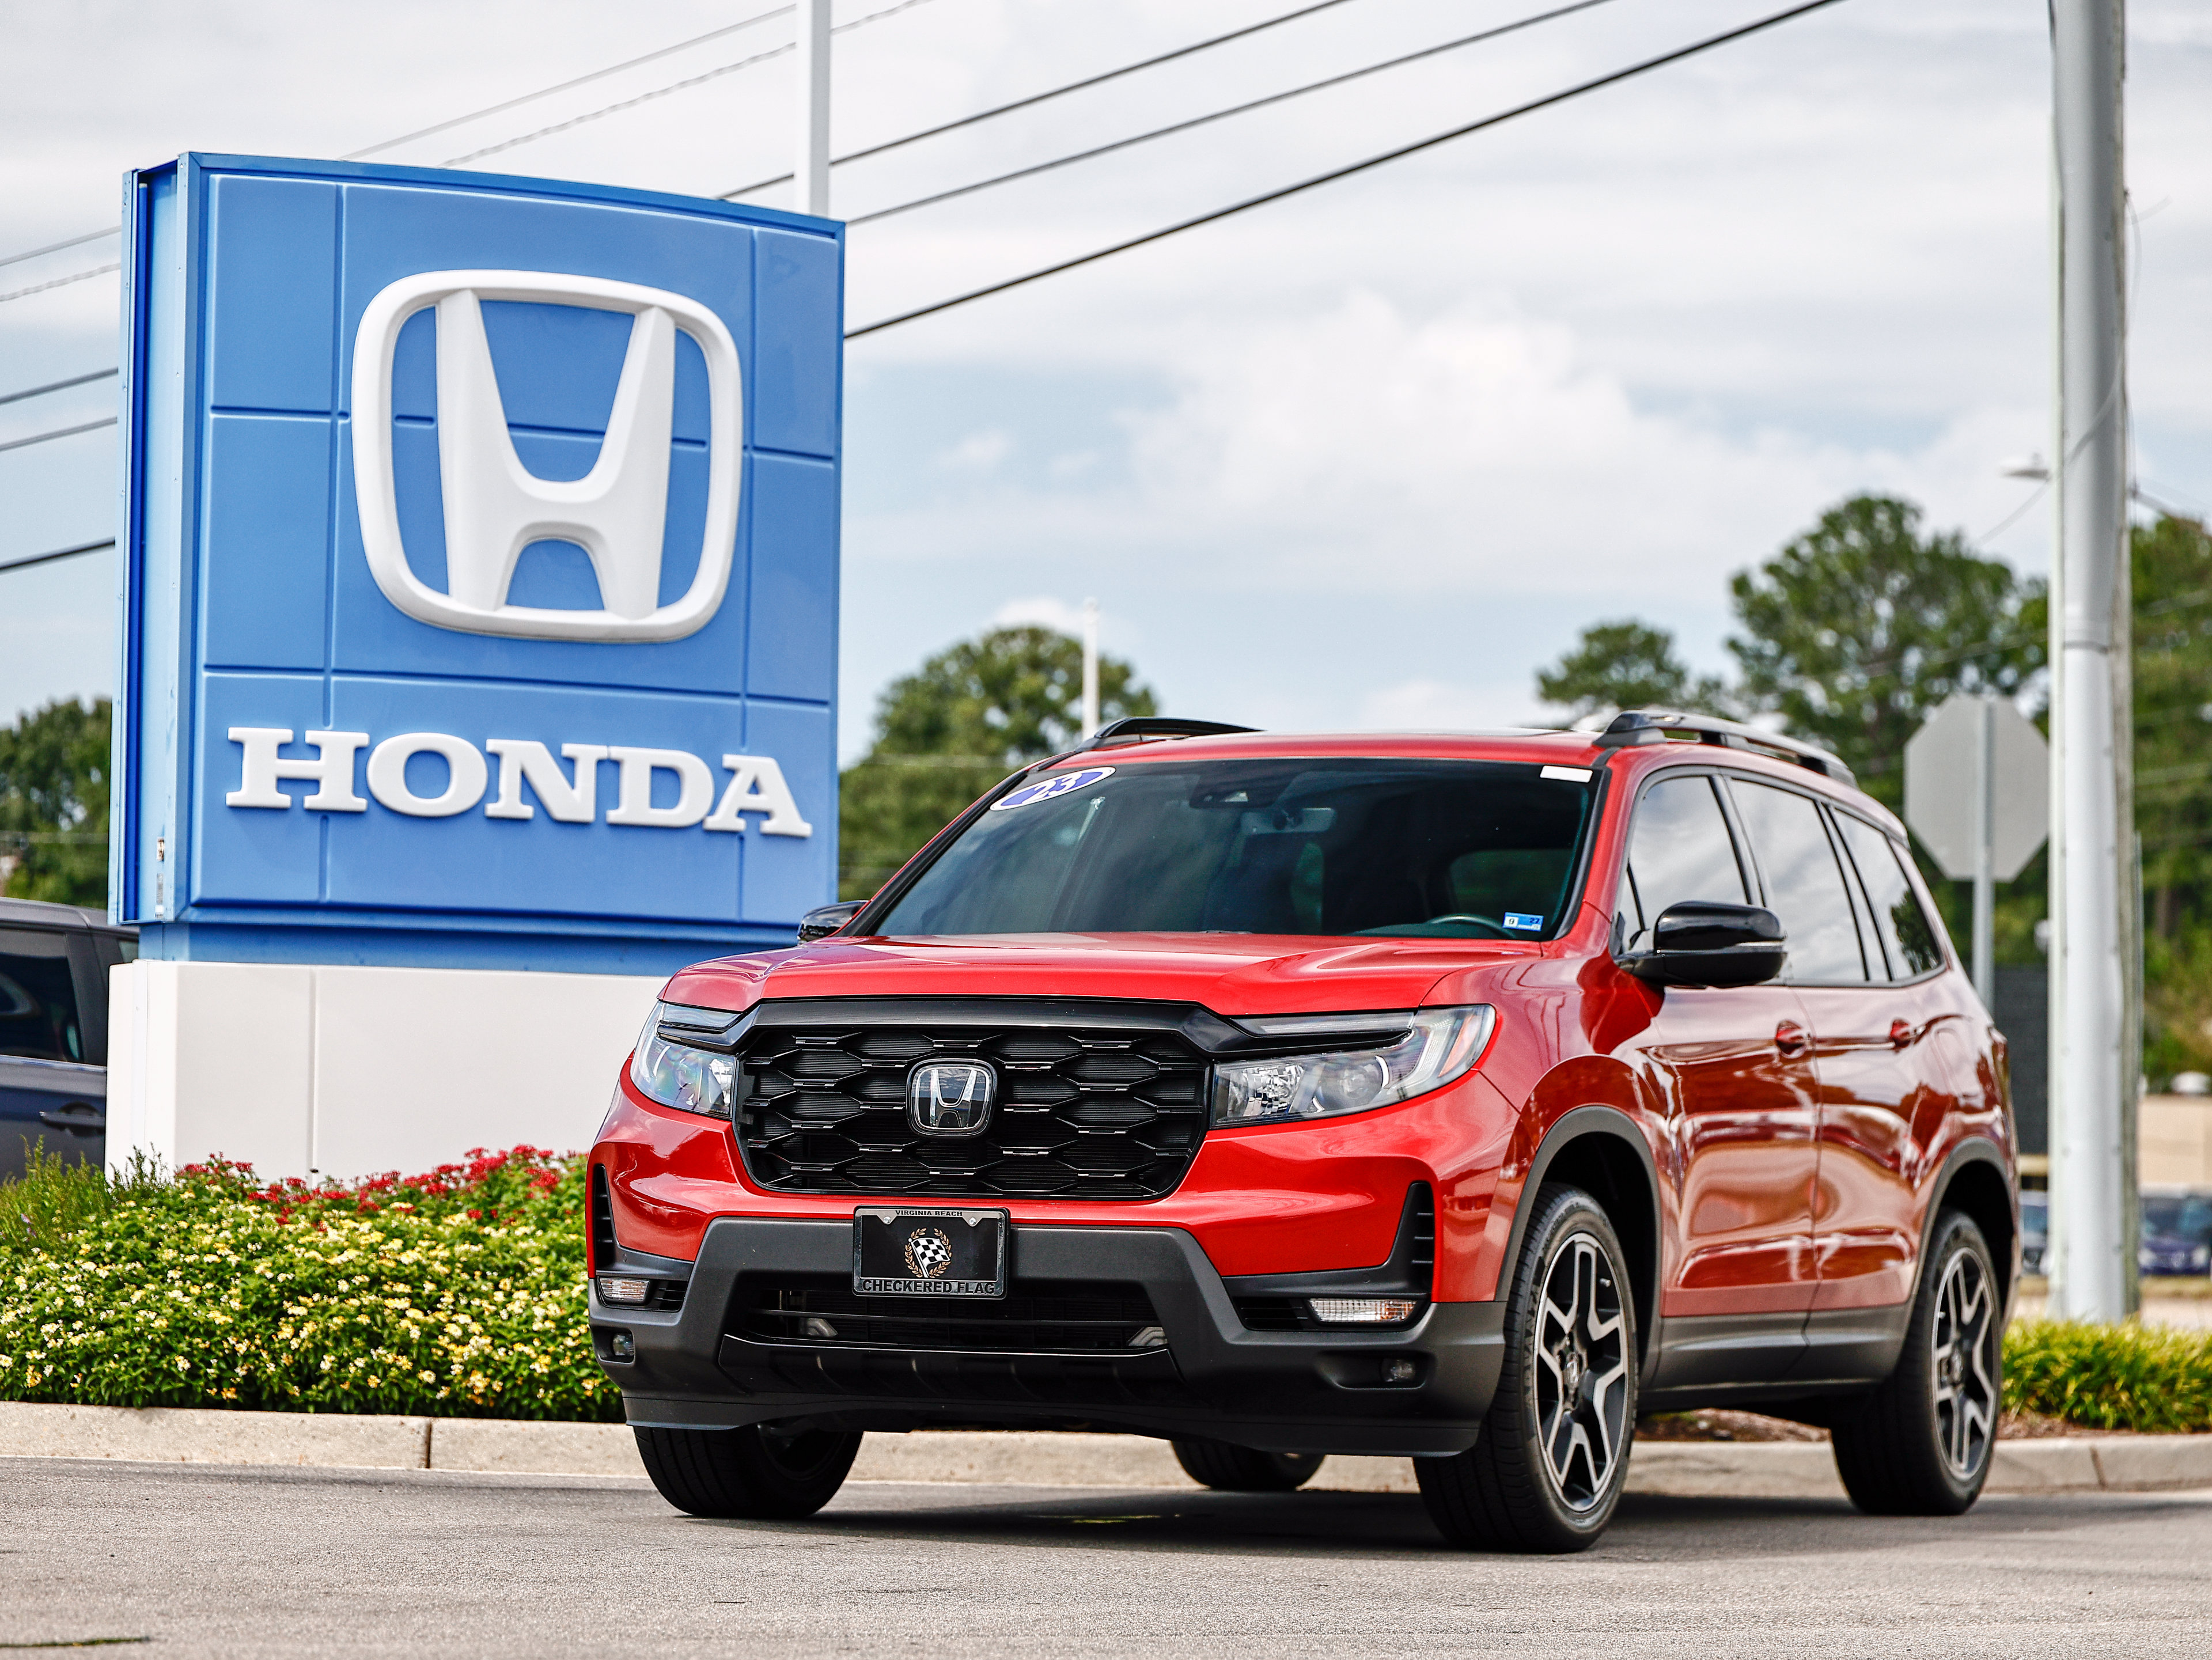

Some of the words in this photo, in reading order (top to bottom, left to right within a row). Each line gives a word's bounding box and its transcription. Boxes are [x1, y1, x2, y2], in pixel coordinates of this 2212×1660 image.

[226, 727, 812, 837] HONDA
[1021, 773, 1082, 804] 23
[862, 1279, 952, 1293] CHECKERED
[957, 1282, 995, 1294] FLAG
